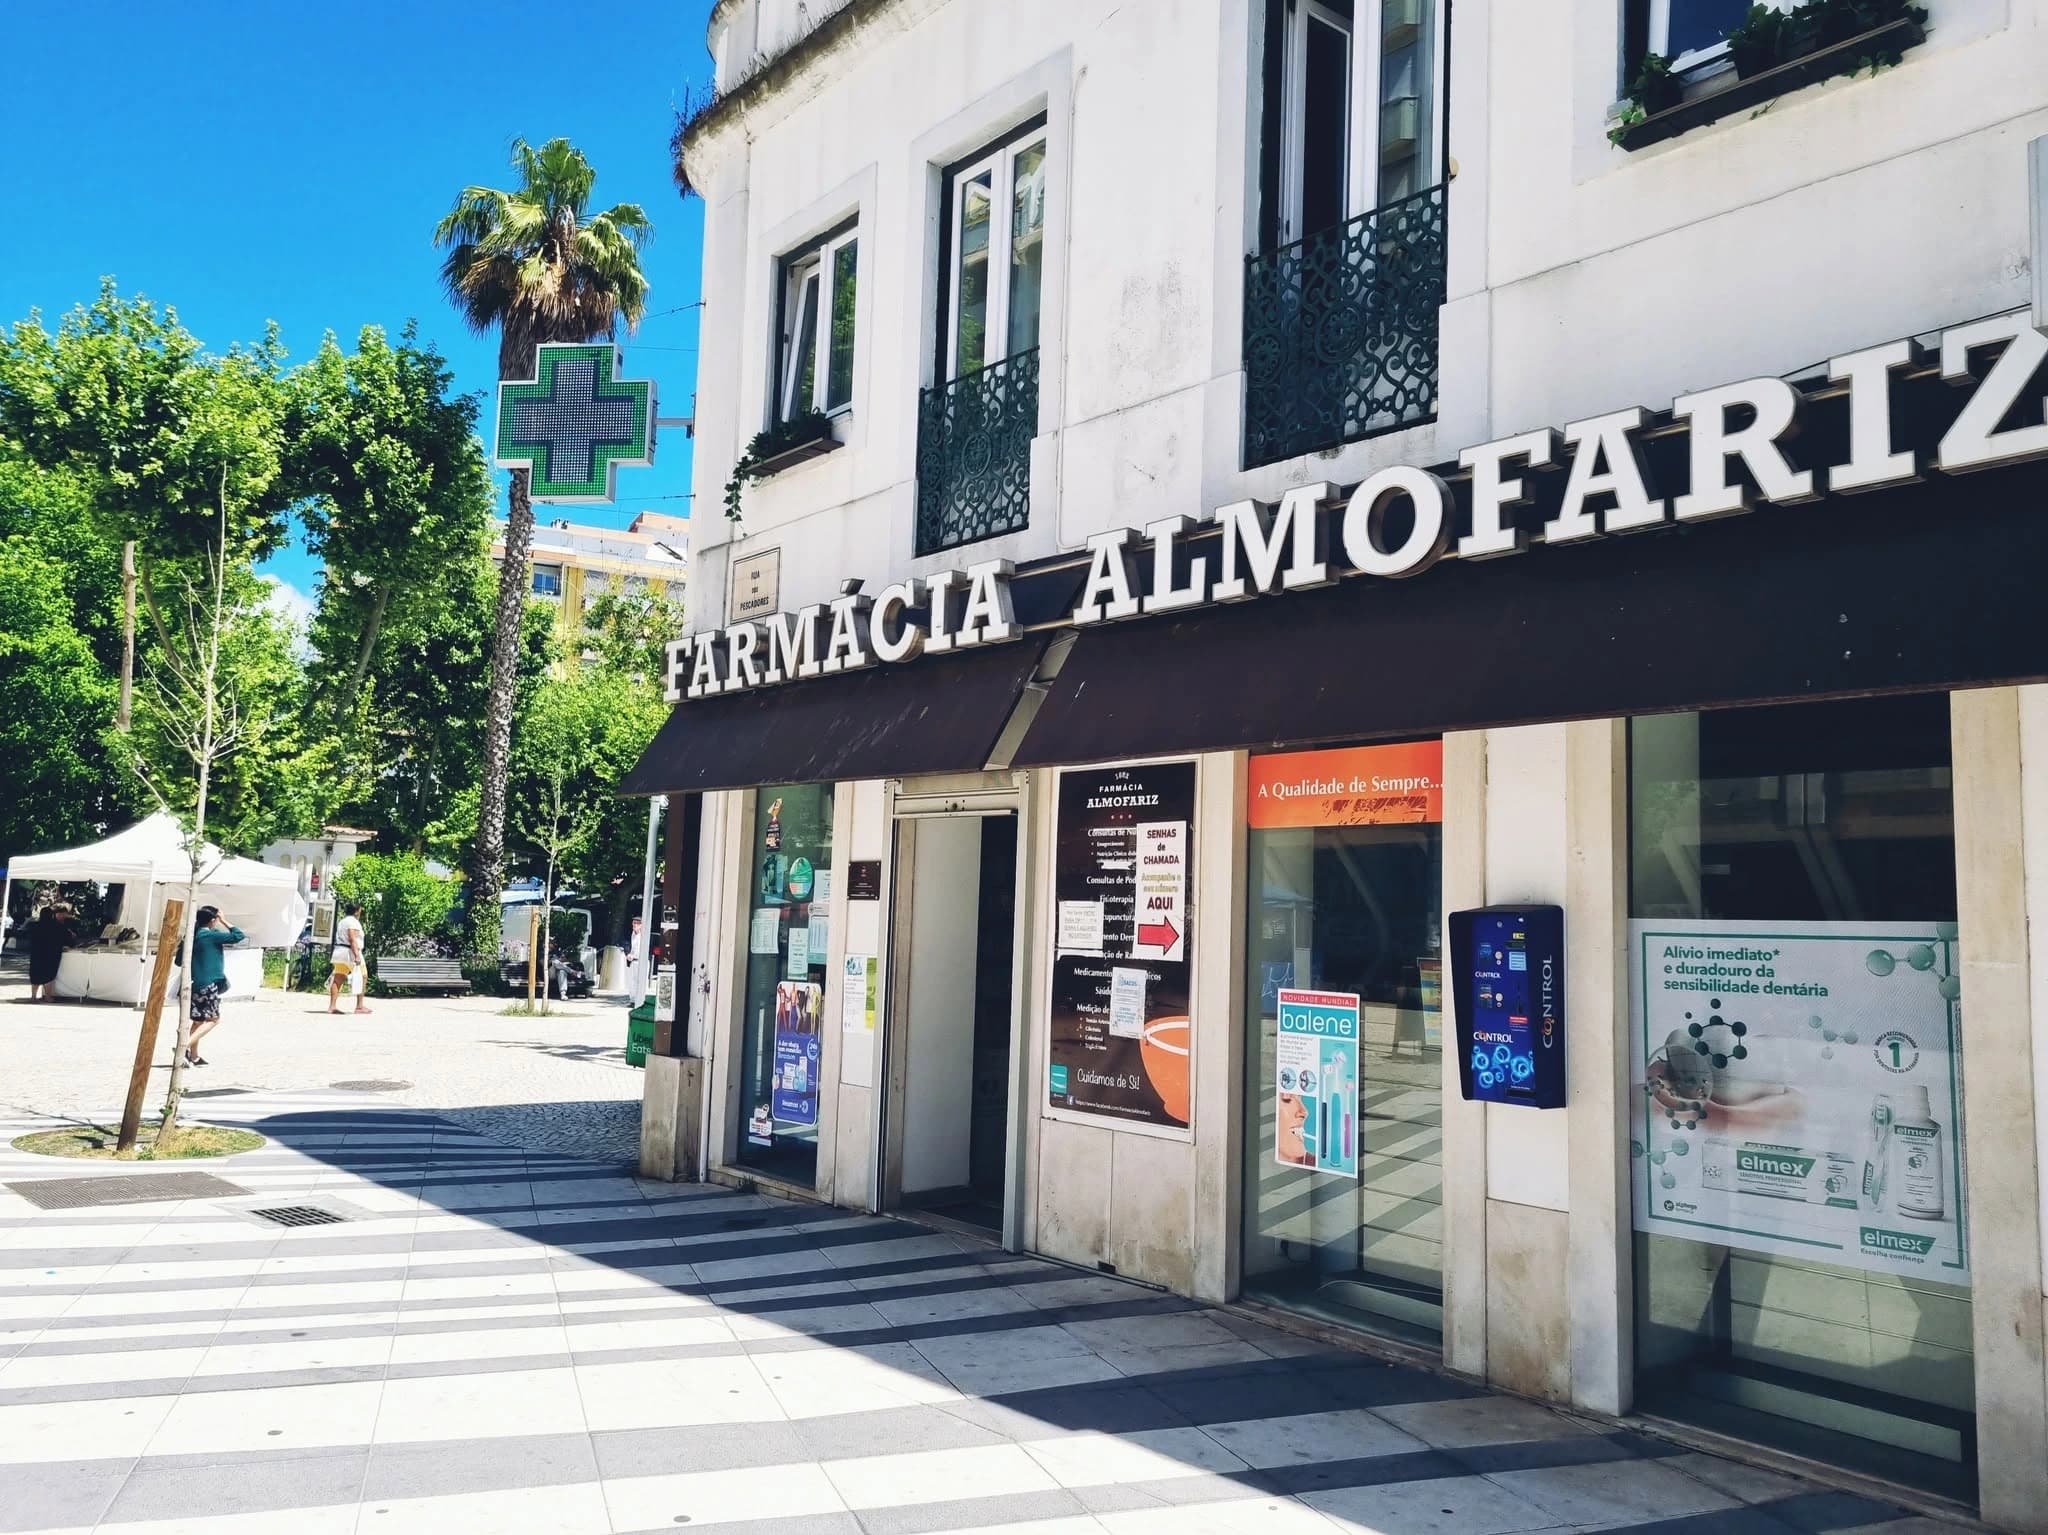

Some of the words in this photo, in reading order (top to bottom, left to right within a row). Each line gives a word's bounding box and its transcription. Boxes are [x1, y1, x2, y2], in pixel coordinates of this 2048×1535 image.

[663, 558, 1019, 702] FARMÁCIA
[1073, 303, 2048, 624] ALMOFARIZ
[751, 570, 760, 580] RUA
[740, 596, 769, 611] PESCADORES
[1099, 783, 1143, 793] FARMÁCIA
[1257, 785, 1268, 798] A
[1272, 777, 1344, 800] Qualidade
[1349, 776, 1367, 793] de
[1087, 794, 1159, 808] ALMOFARIZ
[1147, 829, 1176, 839] SENHAS
[1157, 842, 1166, 851] de
[1143, 855, 1180, 865] CHAMADA
[1086, 876, 1115, 885] Consultas
[1116, 876, 1123, 884] de
[1147, 896, 1173, 910] AQUI
[1103, 914, 1136, 923] cupunctura
[1663, 945, 1703, 961] Alívio
[1074, 968, 1112, 978] Medicamento
[1663, 965, 1673, 975] e
[1675, 962, 1752, 977] duradouro
[1755, 964, 1775, 978] da
[1663, 978, 1761, 994] sensibilidade
[1763, 981, 1829, 998] dentária
[1282, 994, 1318, 1003] NOVIDADE
[1322, 997, 1354, 1006] MUNDIAL
[1077, 1003, 1101, 1014] Medição
[1102, 1005, 1110, 1014] de
[1282, 1008, 1352, 1035] balene
[1887, 1041, 1901, 1068] 1
[1077, 1068, 1114, 1087] Cuidamos
[1117, 1074, 1127, 1088] de
[1897, 1127, 1933, 1138] elmex
[1740, 1155, 1805, 1176] elmex
[1864, 1230, 1923, 1252] elmex
